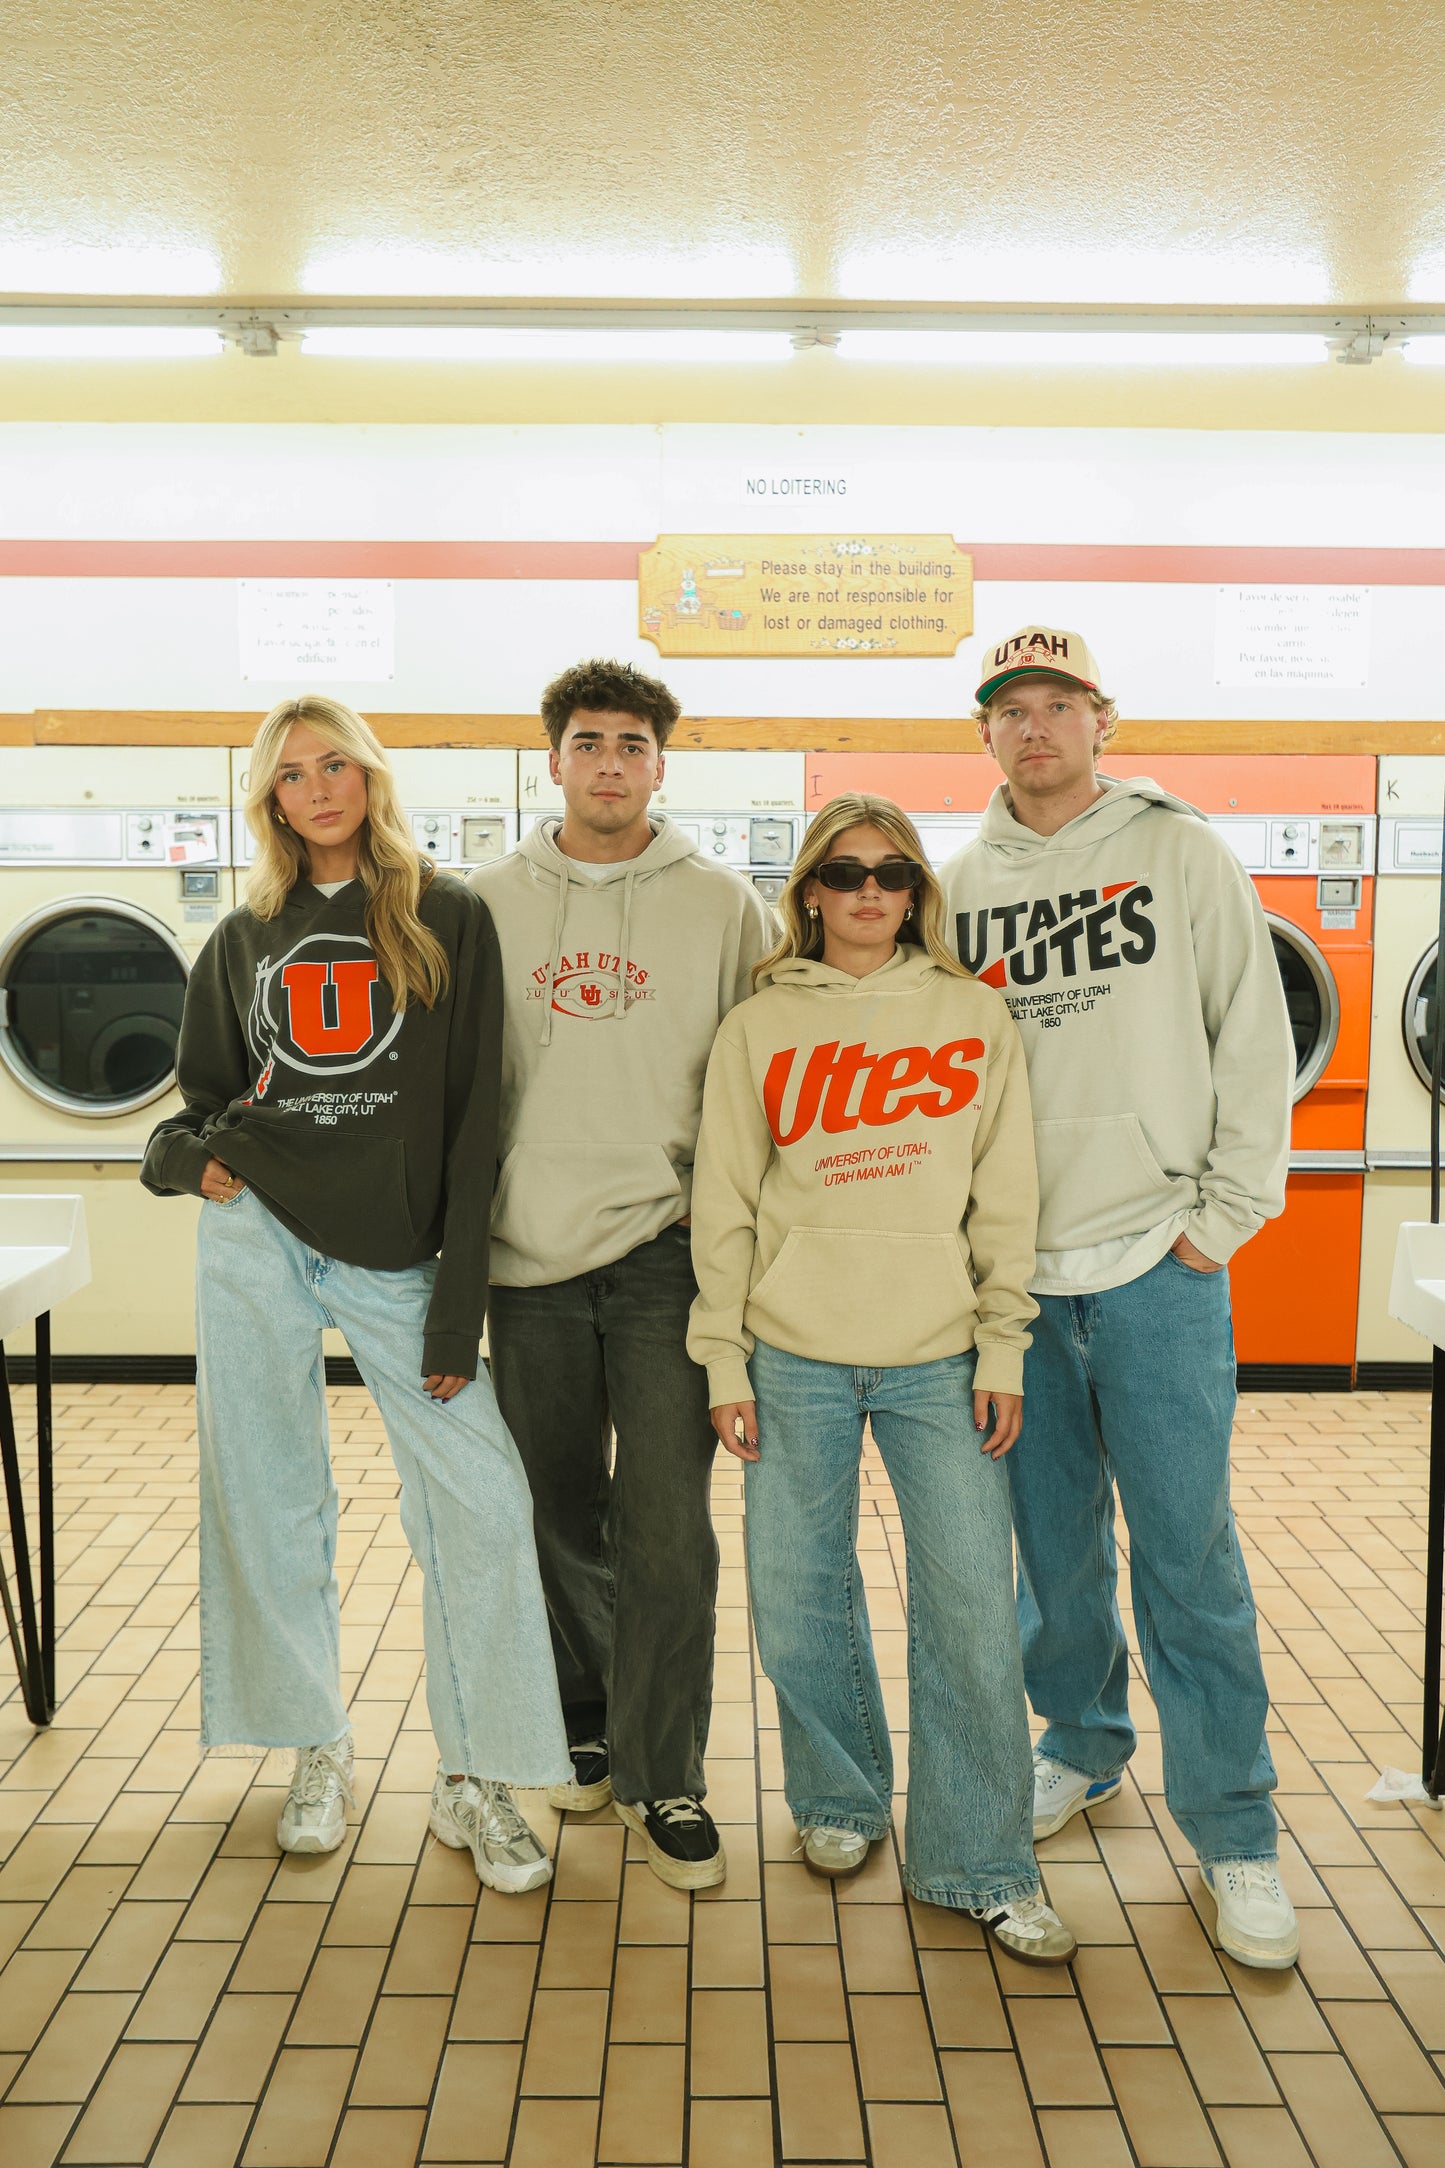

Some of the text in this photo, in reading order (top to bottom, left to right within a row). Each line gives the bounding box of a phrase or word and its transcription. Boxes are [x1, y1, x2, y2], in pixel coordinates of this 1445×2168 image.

[747, 479, 847, 495] NO LOITERING
[761, 560, 955, 578] Please stay in the building.
[760, 588, 954, 606] We are not responsible for
[763, 615, 948, 633] lost or damaged clothing.
[995, 633, 1068, 667] UTAH
[525, 776, 538, 797] H
[1386, 779, 1400, 801] K
[956, 889, 1098, 976] UTAH
[1010, 885, 1157, 986] UTES
[1012, 992, 1065, 1007] UNIVERSITY
[1067, 987, 1082, 1000] OF
[1083, 983, 1111, 999] UTAH
[282, 960, 379, 1058] U
[1030, 1004, 1055, 1018] LAKE
[1055, 1002, 1080, 1015] CITY,
[1081, 999, 1096, 1012] UT
[1040, 1017, 1062, 1029] 1850
[348, 1092, 363, 1103] OF
[763, 1037, 985, 1147] Utes
[305, 1103, 333, 1115] LAKE
[334, 1104, 359, 1117] CITY,
[361, 1104, 377, 1115] UT
[313, 1114, 338, 1126] 1850
[814, 1149, 877, 1172] UNIVERSITY
[876, 1145, 896, 1160] OF
[824, 1172, 854, 1187] UTAH
[856, 1166, 885, 1180] MAN
[885, 1162, 905, 1177] AM
